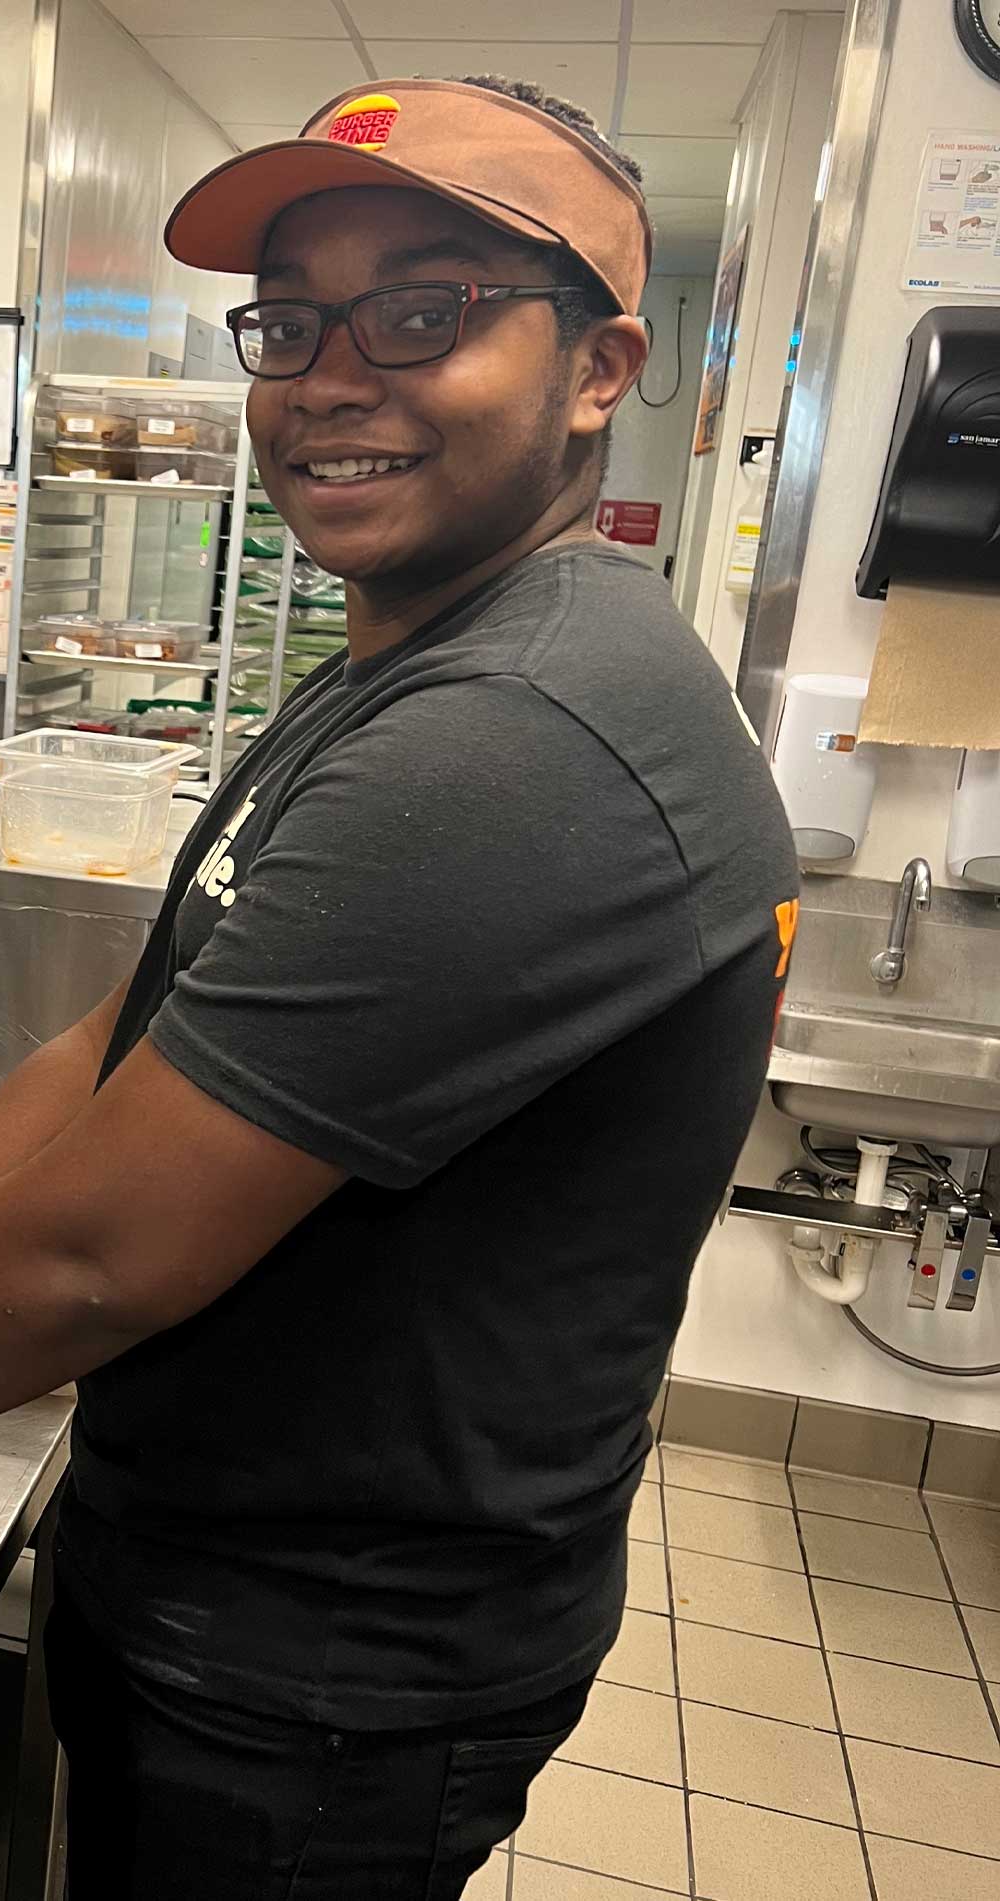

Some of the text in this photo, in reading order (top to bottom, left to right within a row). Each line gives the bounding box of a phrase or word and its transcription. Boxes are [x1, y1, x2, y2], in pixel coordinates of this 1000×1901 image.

[332, 111, 397, 134] BURGER
[328, 124, 391, 146] KING
[908, 278, 940, 288] ECOLAB
